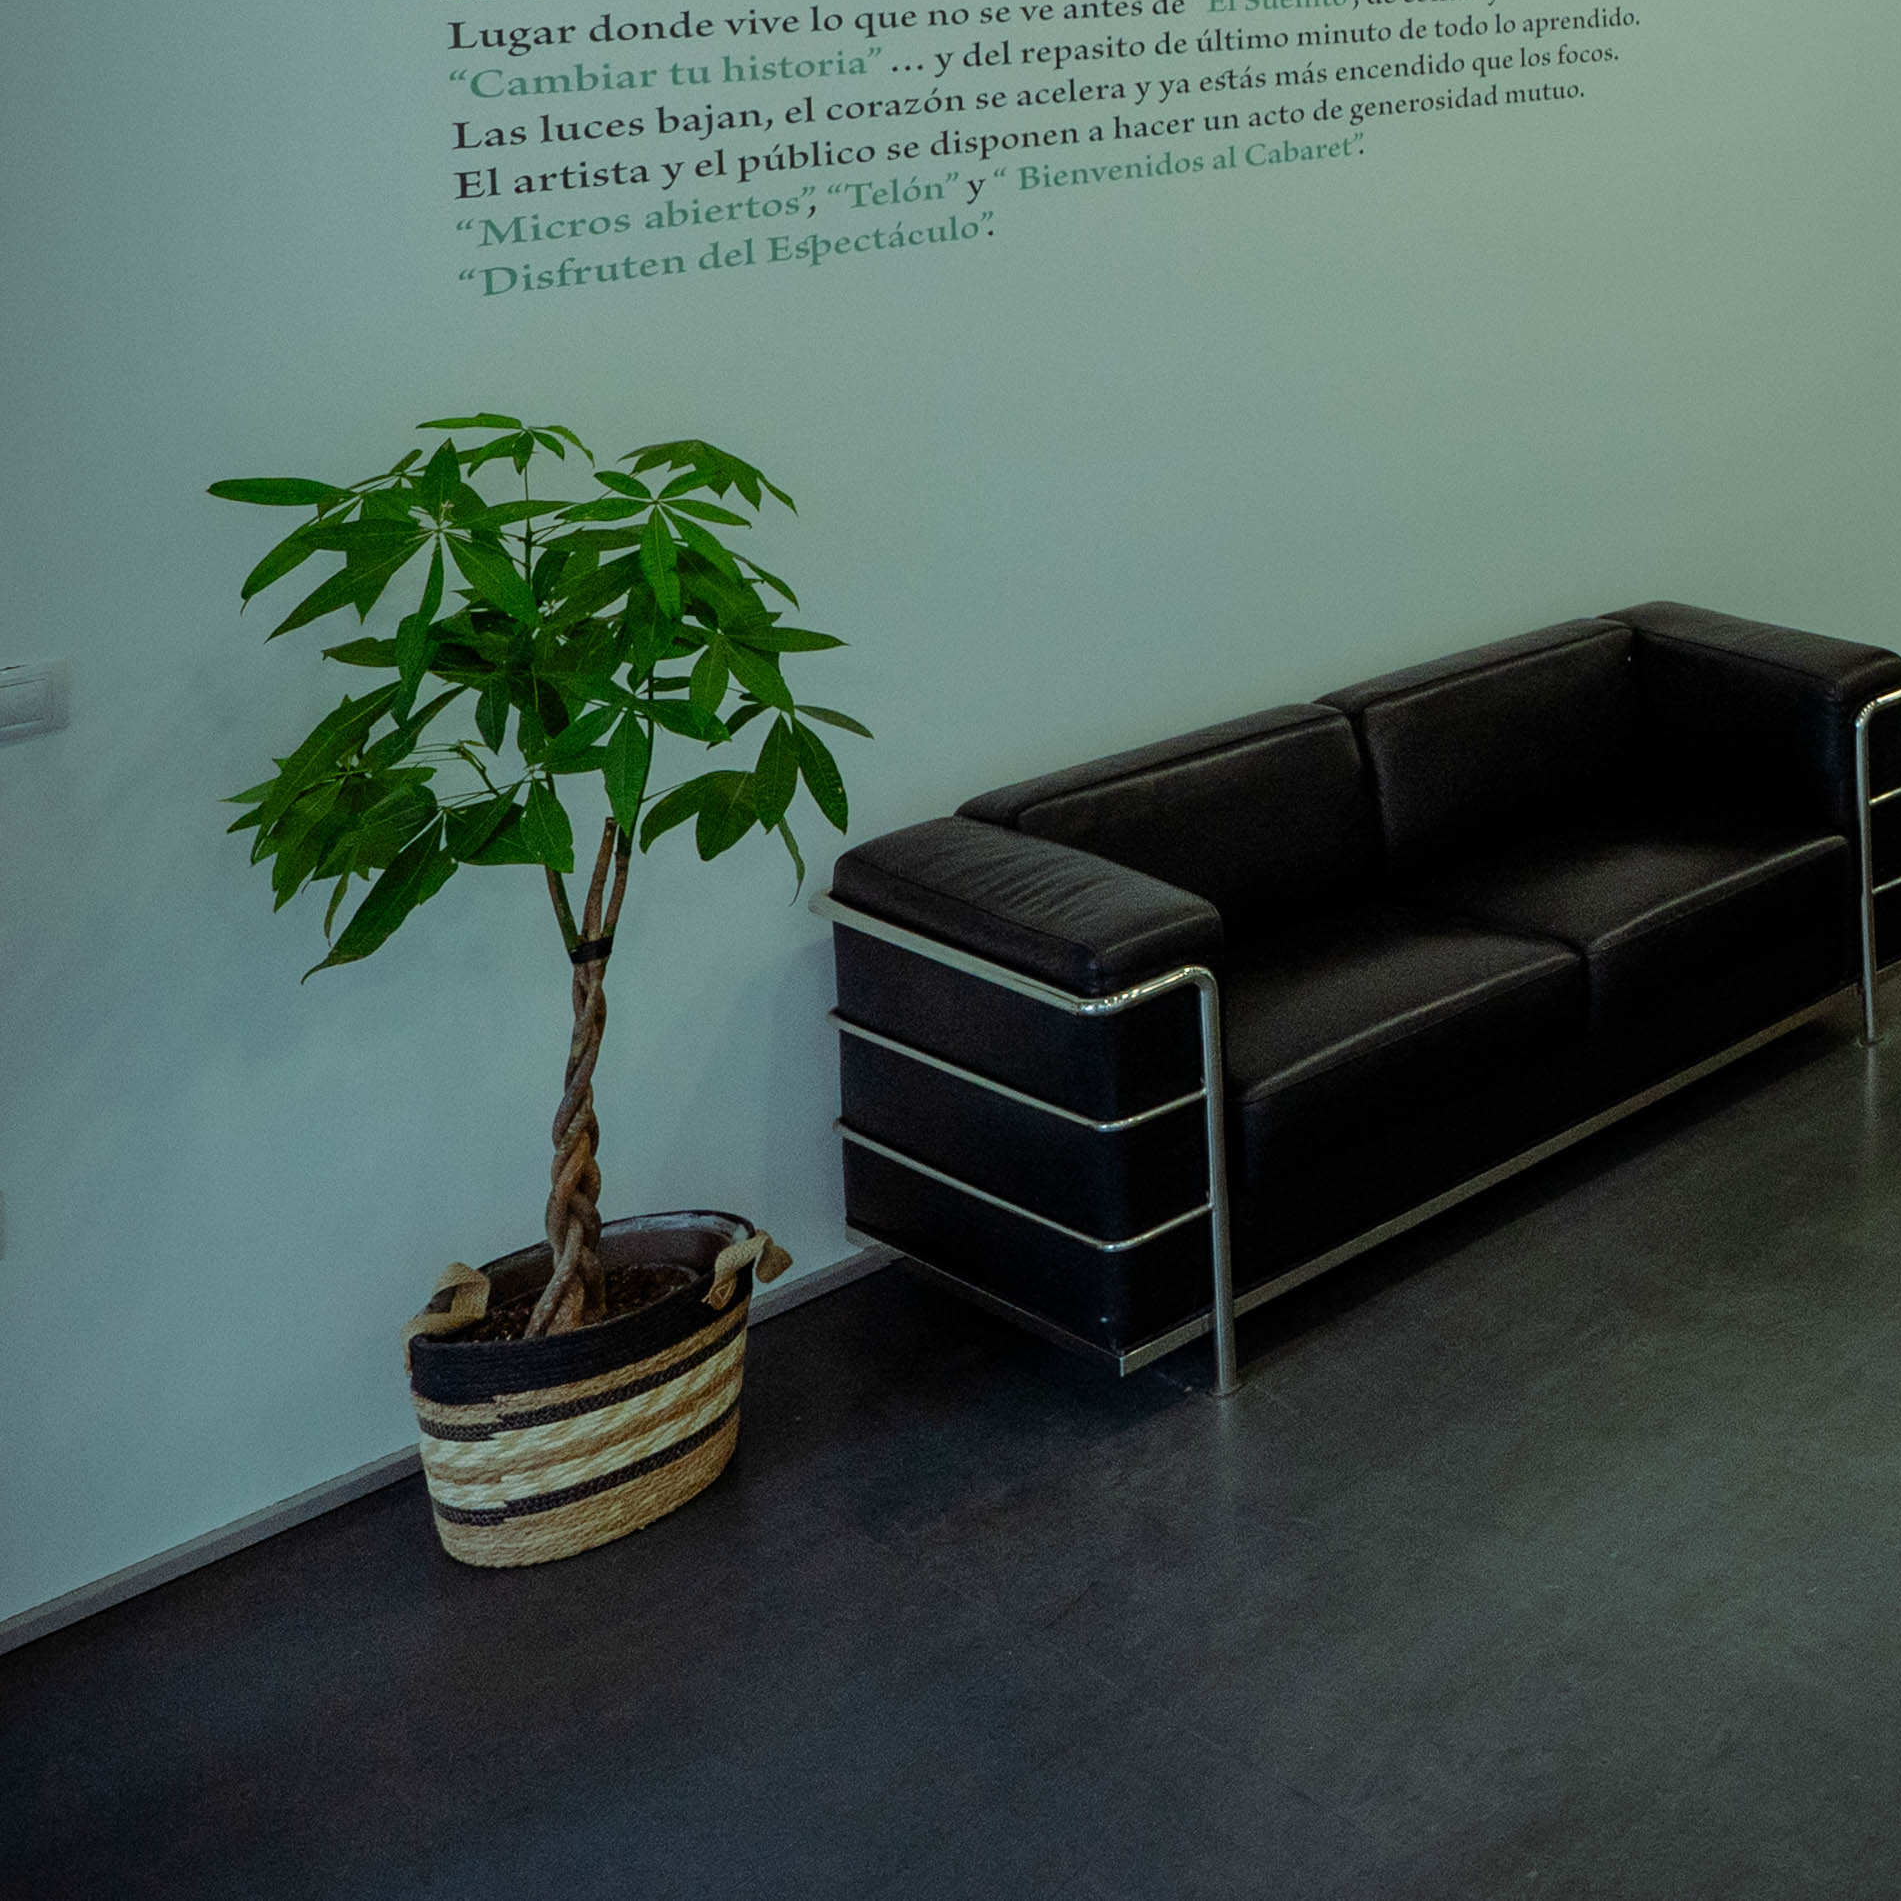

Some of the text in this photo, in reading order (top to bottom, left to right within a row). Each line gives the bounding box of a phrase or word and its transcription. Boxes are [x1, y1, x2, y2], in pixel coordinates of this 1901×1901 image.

[447, 20, 577, 58] Lugar
[588, 9, 715, 43] donde
[724, 8, 800, 36] vive
[809, 4, 844, 33] lo
[853, 10, 918, 39] que
[928, 8, 970, 27] no
[979, 6, 1011, 25] se
[1019, 4, 1054, 22] ve
[669, 62, 711, 86] tu
[934, 51, 955, 79] y
[962, 39, 1013, 68] del
[1021, 35, 1146, 71] repasito
[1154, 30, 1188, 56] de
[1196, 27, 1290, 54] último
[1297, 22, 1392, 47] minuto
[1398, 17, 1428, 41] de
[1434, 14, 1489, 39] todo
[1494, 12, 1517, 35] lo
[1522, 5, 1641, 39] aprendido.
[452, 43, 1619, 150] Las luces bajan, el corazón se acelera y ya estás más encendido que los focos.
[453, 83, 1585, 200] El artista y el público se disponen a hacer un acto de generosidad mutuo.
[966, 178, 987, 206] y
[1212, 145, 1237, 171] al
[698, 237, 756, 271] del
